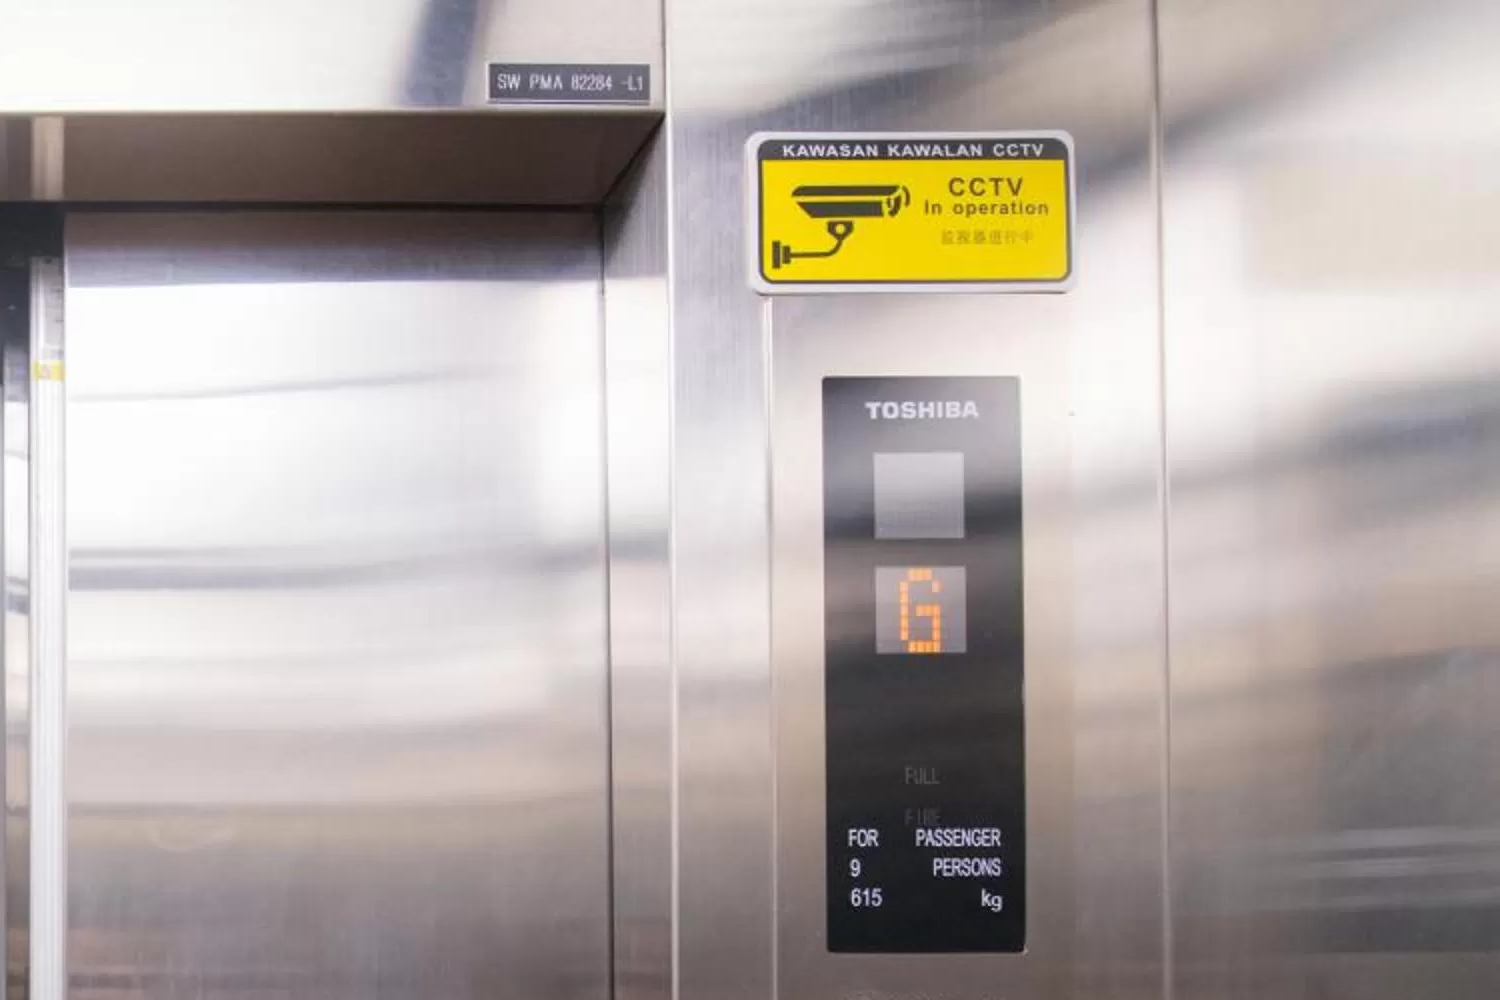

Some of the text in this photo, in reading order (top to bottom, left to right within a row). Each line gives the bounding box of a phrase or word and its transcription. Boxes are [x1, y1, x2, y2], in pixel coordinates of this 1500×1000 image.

[497, 73, 521, 90] SW
[530, 73, 563, 90] PMA
[783, 143, 1044, 157] KAWASAN KAWALAN CCTV
[948, 177, 1024, 197] CCTV
[952, 200, 1049, 218] operation
[865, 401, 979, 420] TOSHIBA
[900, 568, 941, 653] G
[848, 828, 1001, 847] FOR PASSENGER
[850, 857, 1001, 877] 9 PERSONS
[851, 888, 1003, 912] 615 kg
